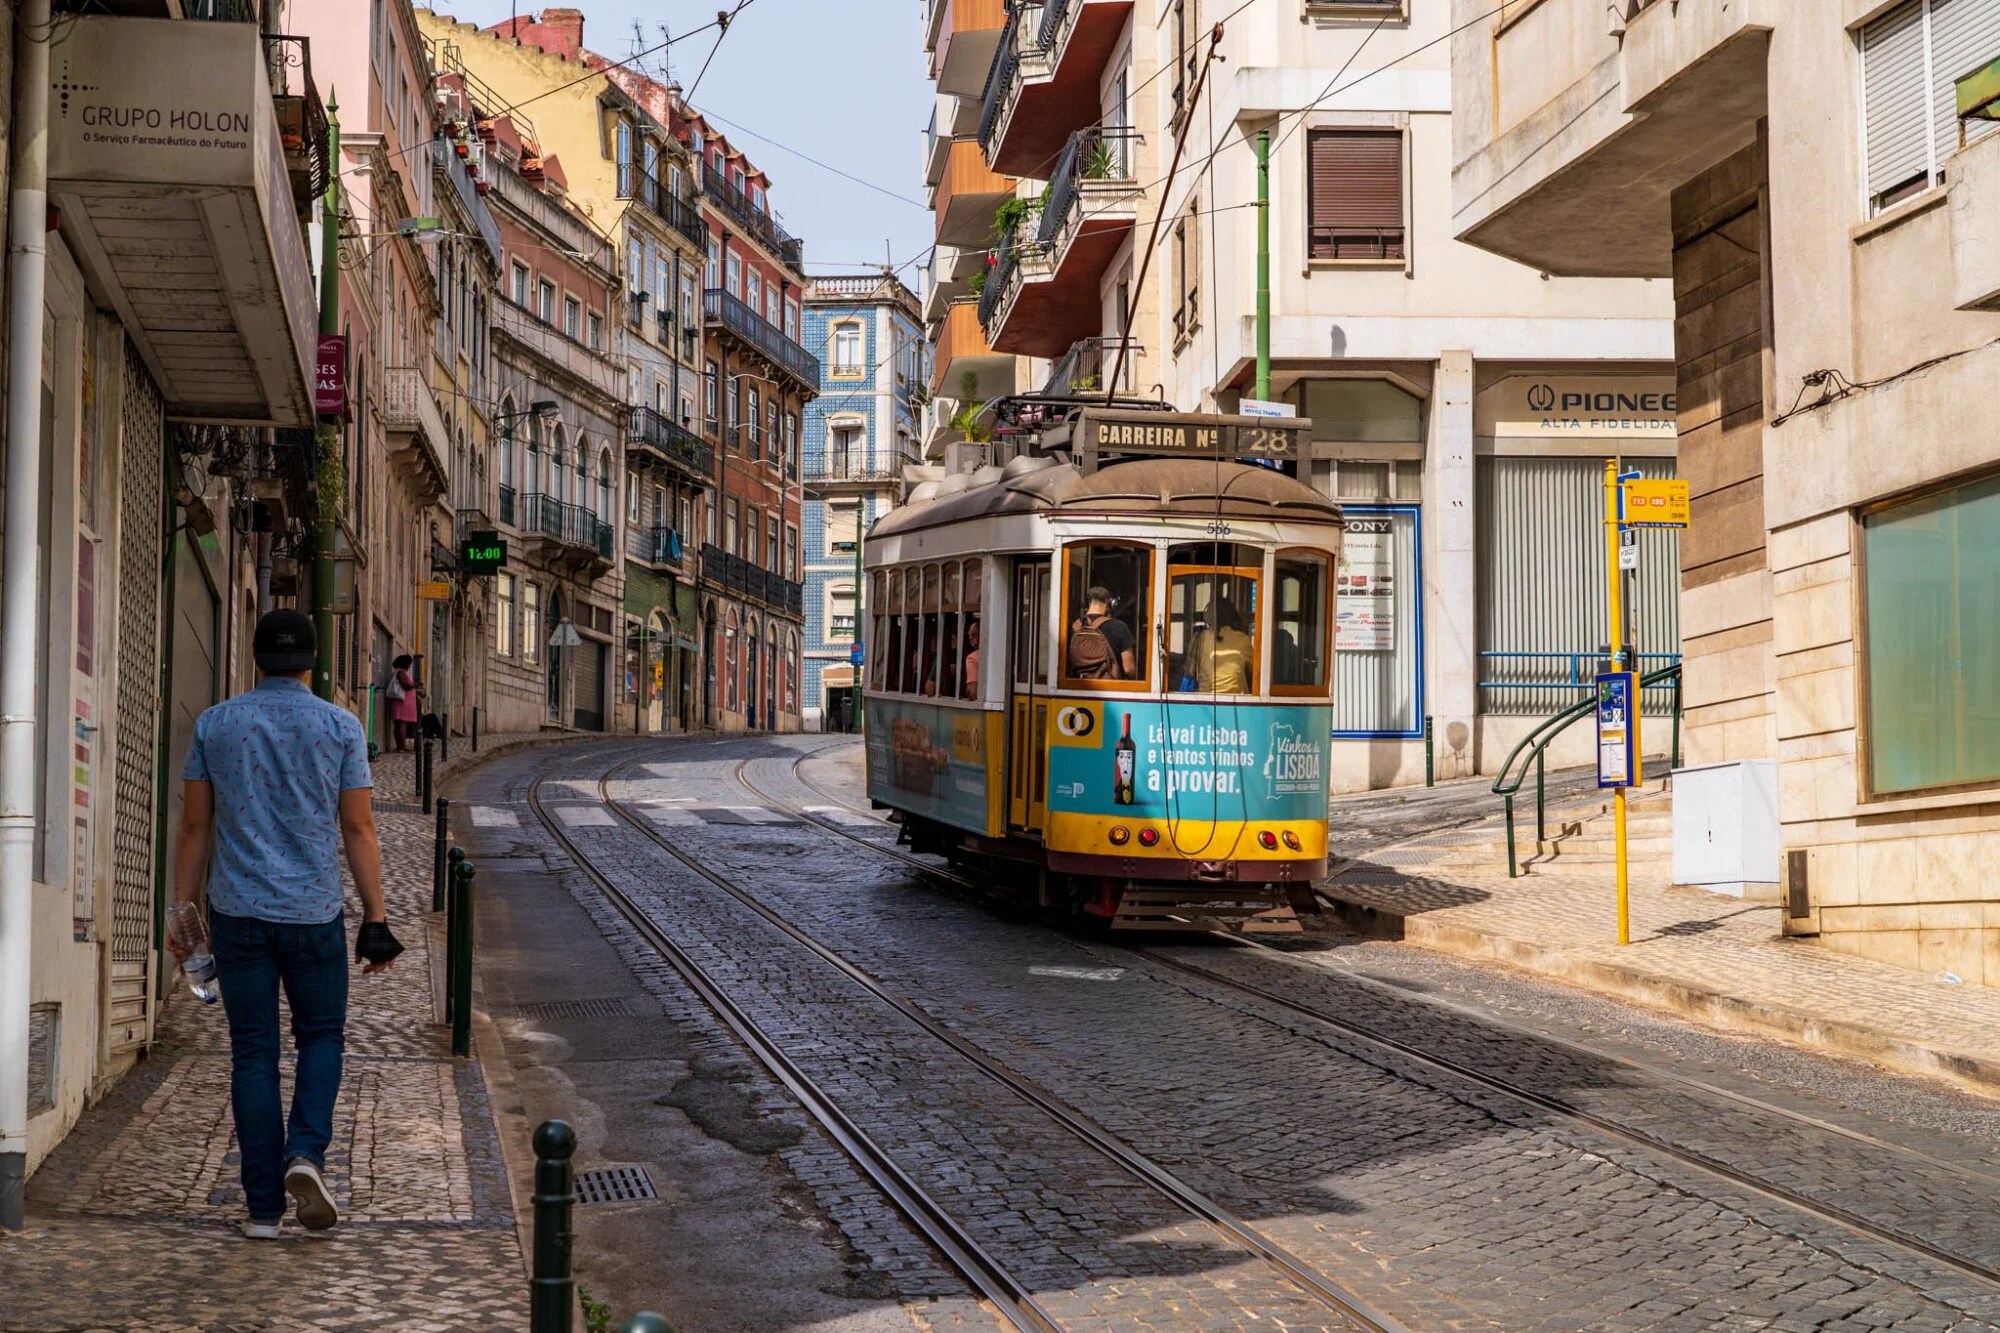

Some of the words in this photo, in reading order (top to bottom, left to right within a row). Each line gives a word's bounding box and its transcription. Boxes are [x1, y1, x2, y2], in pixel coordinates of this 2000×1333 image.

[82, 105, 161, 128] GRUPO
[170, 109, 249, 133] HOLON
[83, 132, 91, 142] O
[93, 133, 130, 145] Serviço
[132, 134, 197, 147] Farmacêutico
[199, 138, 212, 148] do
[214, 139, 247, 149] Futuro
[1541, 418, 1581, 429] ALTA
[1590, 419, 1677, 429] FIDELIDA
[1099, 424, 1186, 447] CARREIRA
[1250, 428, 1288, 452] 28
[1149, 721, 1166, 744] Lá
[1170, 724, 1195, 745] vai
[1199, 724, 1248, 746] Lisboa
[1277, 734, 1312, 753] Vinhos
[1148, 749, 1157, 764] e
[1161, 748, 1206, 766] tantos
[1210, 748, 1255, 767] vinhos
[1276, 754, 1320, 780] LISBOA
[1147, 768, 1160, 791] a
[1167, 769, 1241, 800] provar.
